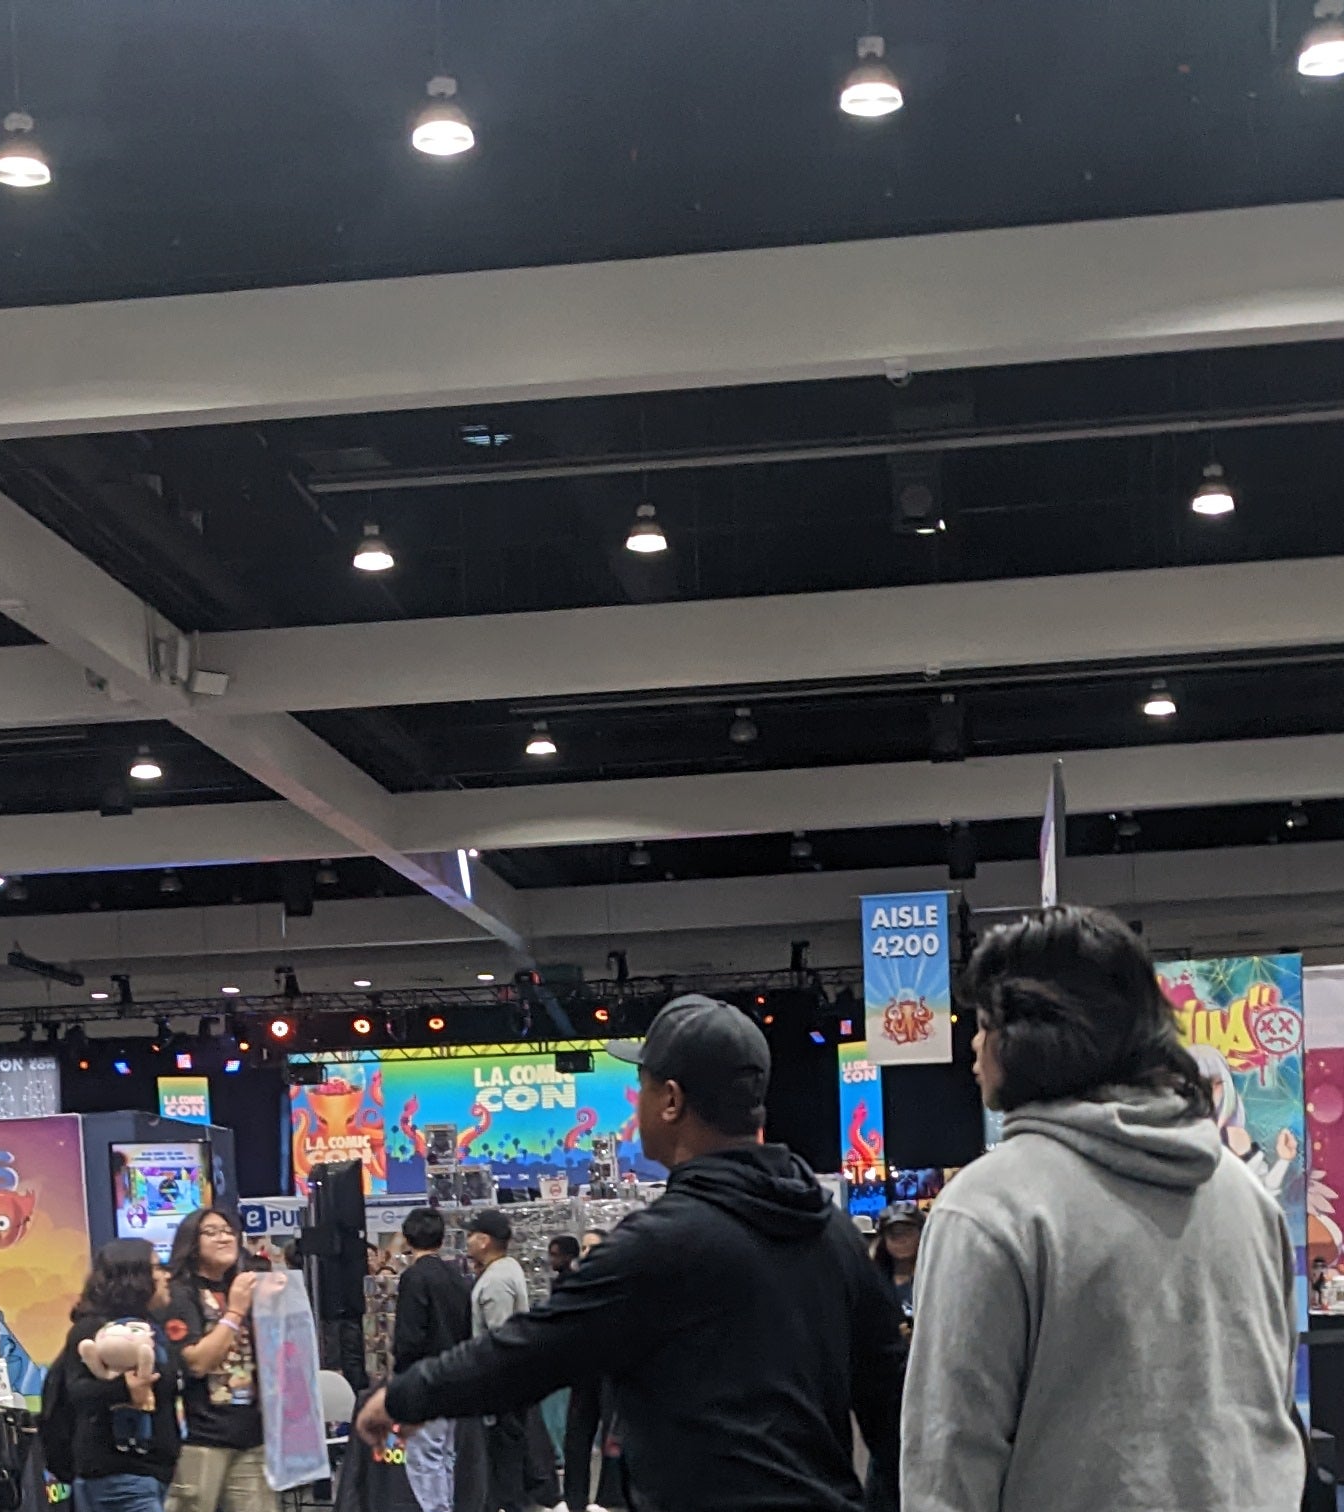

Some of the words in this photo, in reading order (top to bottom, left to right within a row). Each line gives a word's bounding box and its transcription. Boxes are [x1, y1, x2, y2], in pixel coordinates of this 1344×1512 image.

[871, 905, 938, 929] AISLE
[872, 933, 939, 957] 4200
[474, 1067, 509, 1087] L.A.
[843, 1069, 878, 1084] CON
[476, 1085, 576, 1112] CON
[164, 1104, 206, 1117] CON
[307, 1138, 328, 1151] L.A.
[327, 1135, 371, 1149] COMIC
